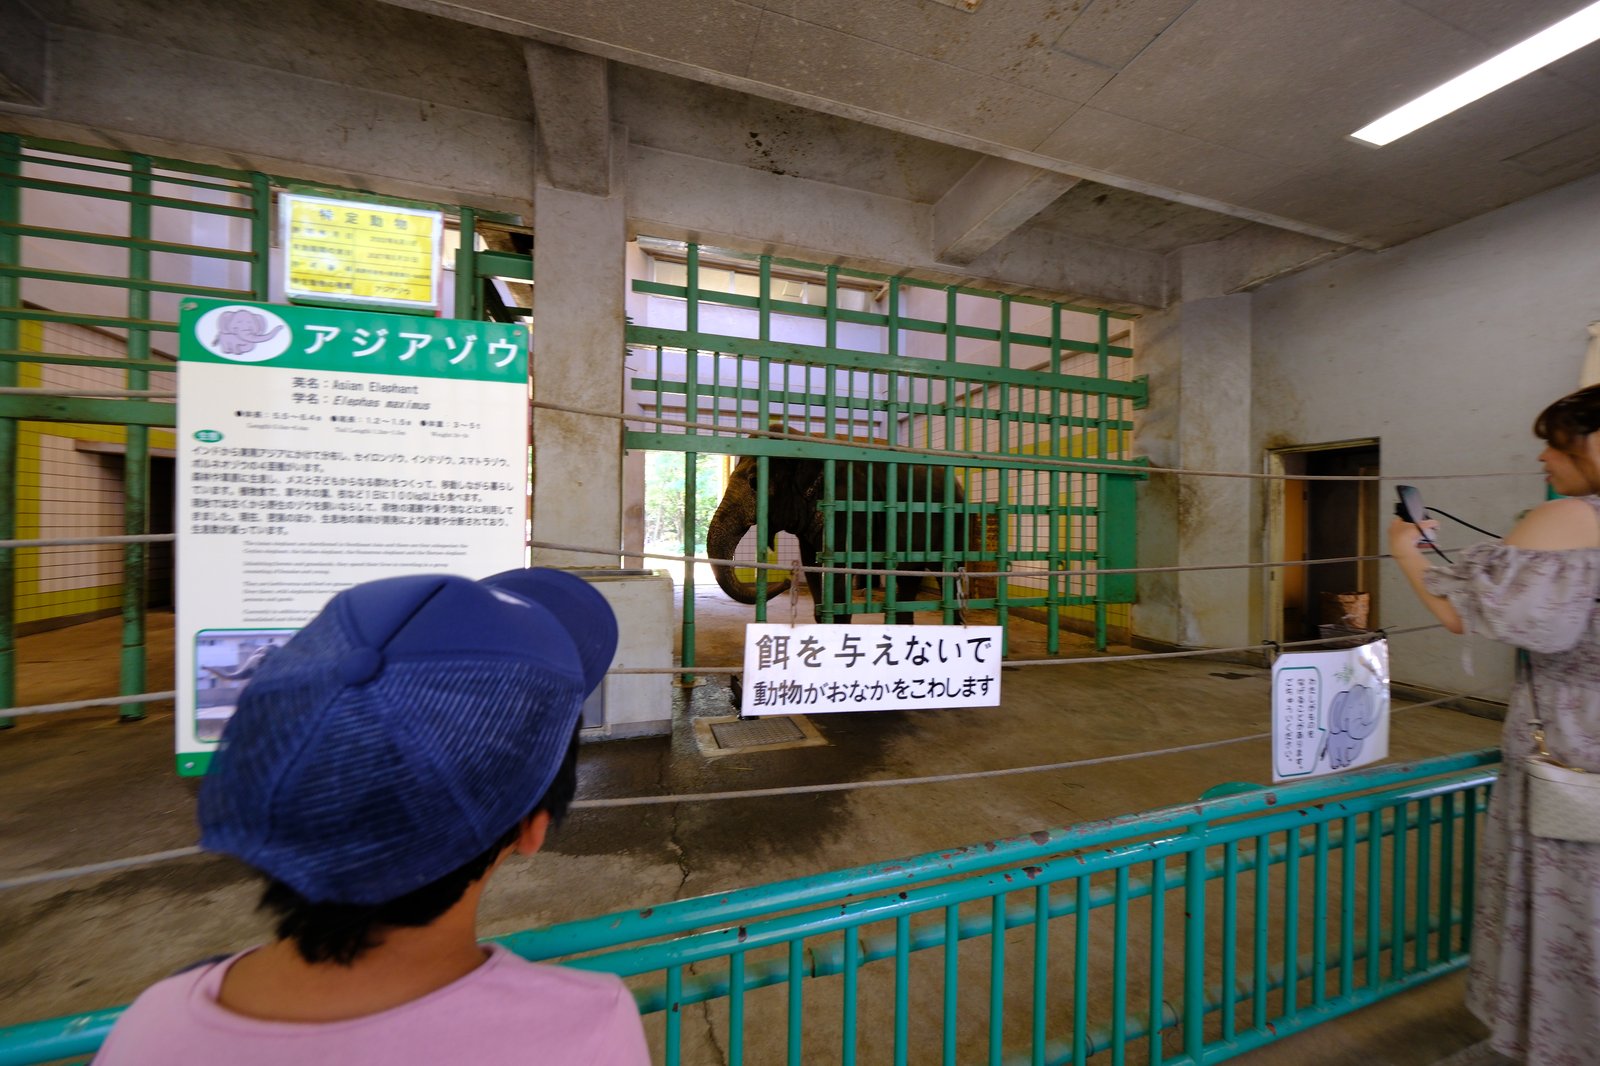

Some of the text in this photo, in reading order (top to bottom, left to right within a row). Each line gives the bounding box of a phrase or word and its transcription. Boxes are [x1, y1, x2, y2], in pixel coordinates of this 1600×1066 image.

[303, 324, 518, 368] アジアゾウ
[333, 395, 381, 408] Elephas
[384, 400, 431, 411] maximus
[369, 382, 419, 396] Elephant
[755, 633, 992, 671] 餌を与えないで
[753, 675, 994, 706] 動物がおなかをこわします
